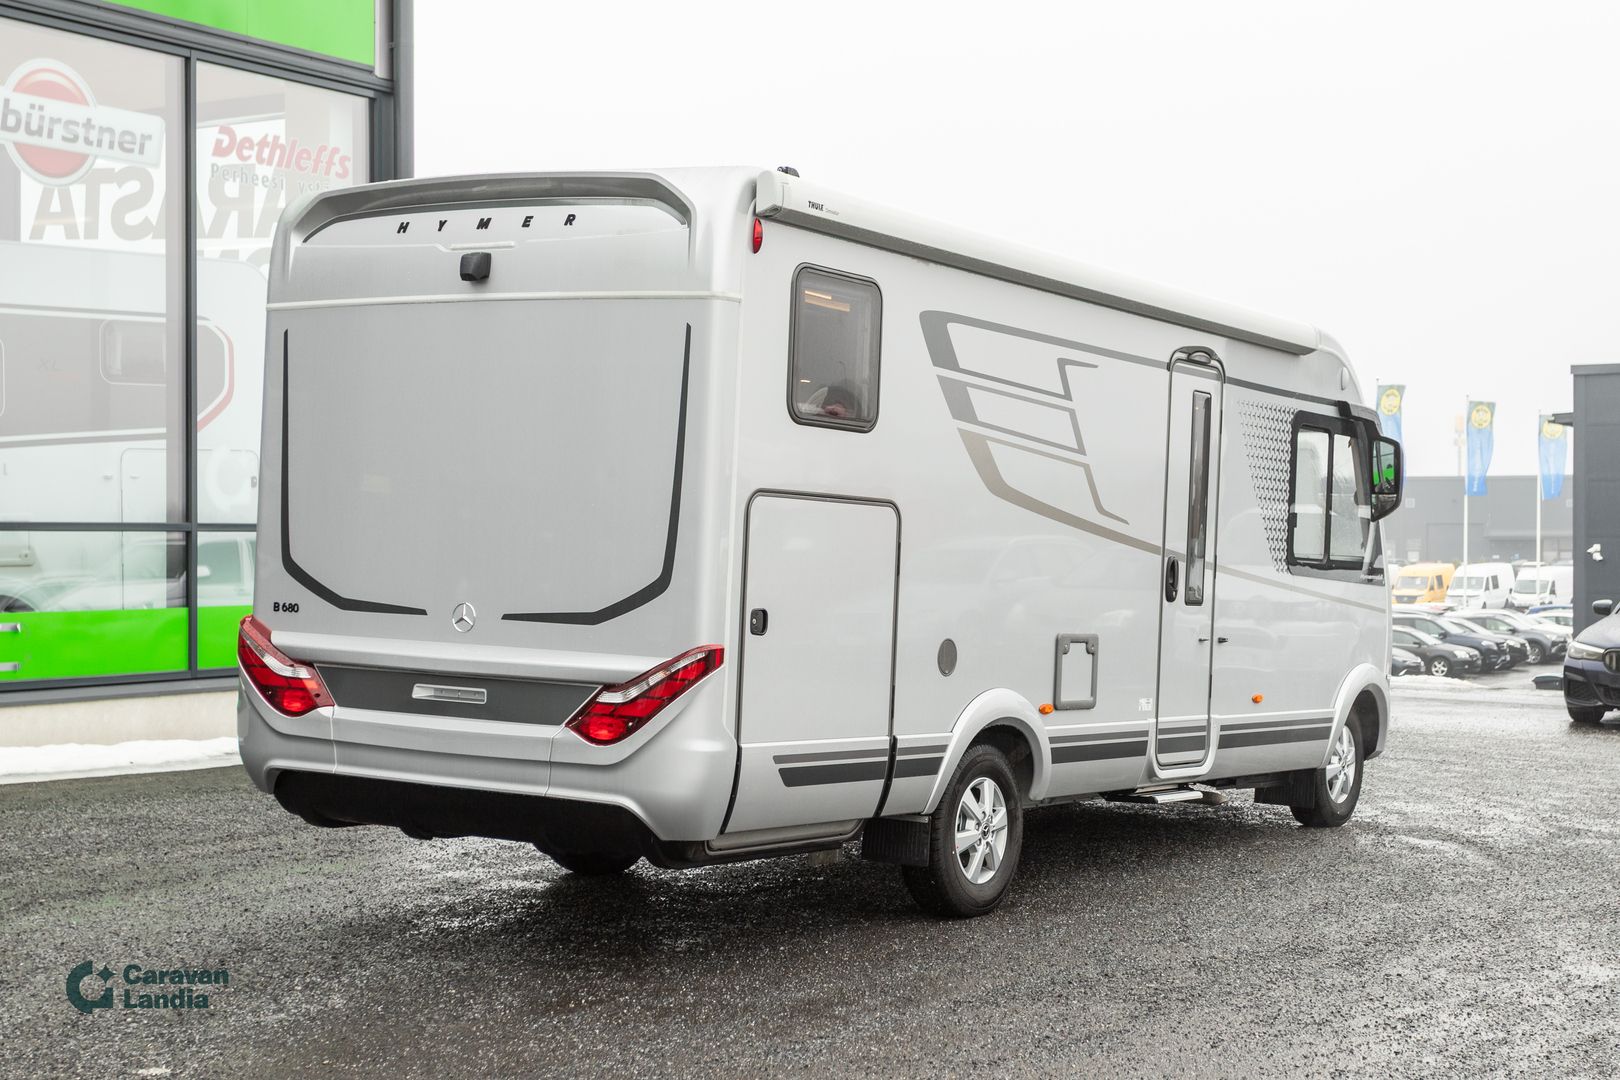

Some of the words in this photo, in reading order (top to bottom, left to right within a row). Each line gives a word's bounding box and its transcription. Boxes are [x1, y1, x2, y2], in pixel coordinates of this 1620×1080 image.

[1, 98, 153, 156] bürstner
[211, 124, 352, 179] Dethleffs
[211, 162, 285, 191] Perheesi
[807, 200, 824, 212] THULE
[397, 213, 576, 234] HYMER
[273, 602, 280, 612] B
[281, 602, 300, 613] 680
